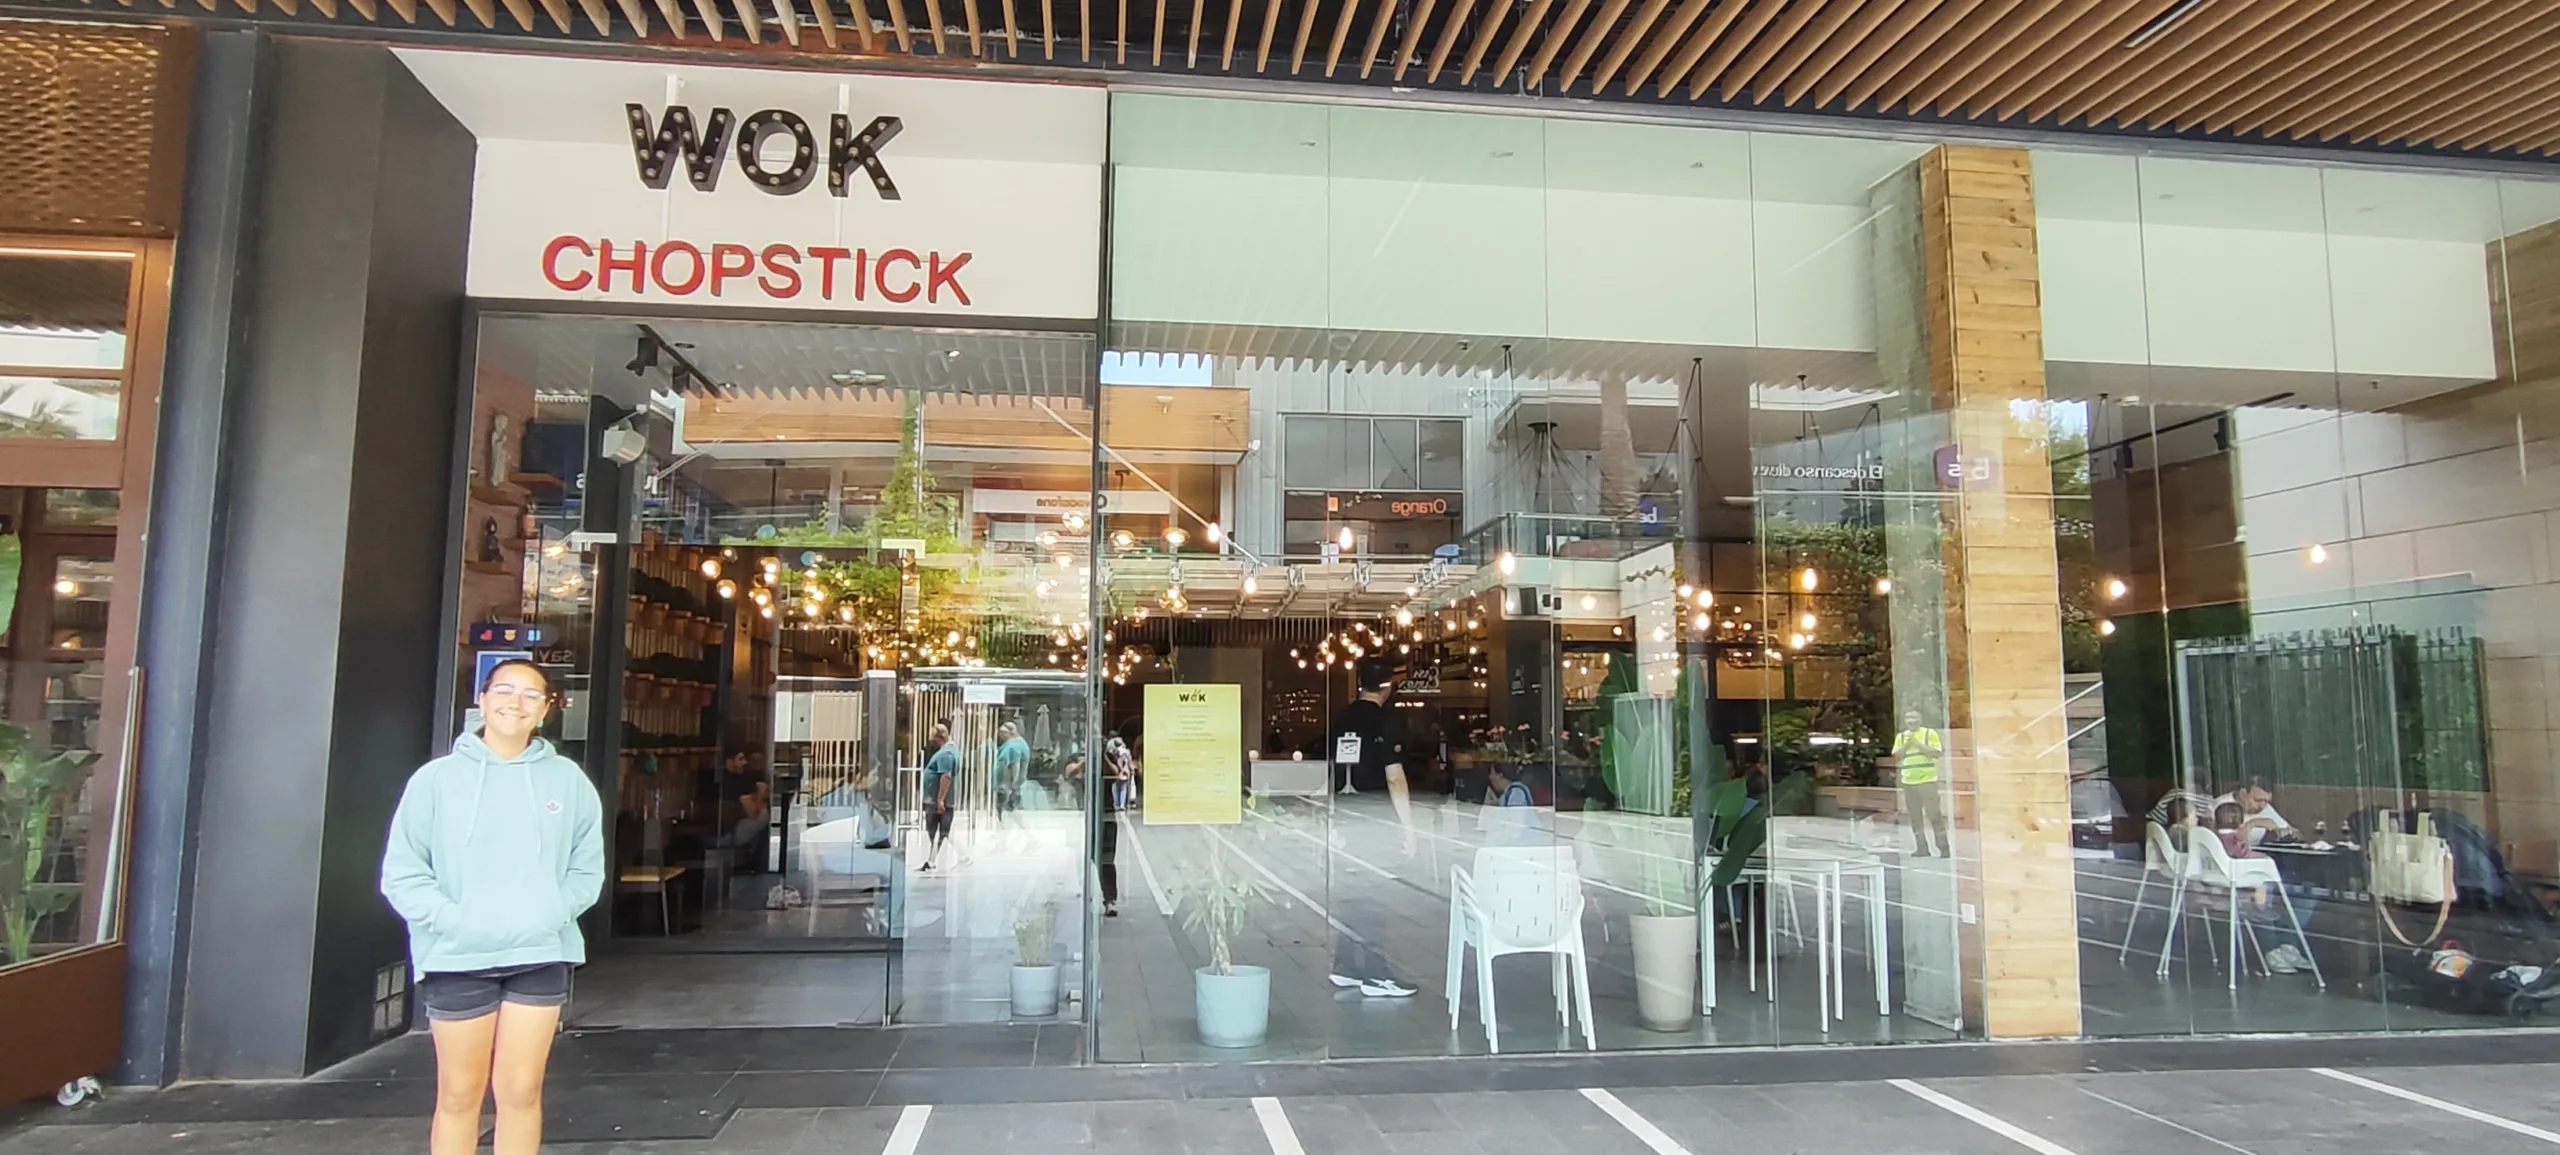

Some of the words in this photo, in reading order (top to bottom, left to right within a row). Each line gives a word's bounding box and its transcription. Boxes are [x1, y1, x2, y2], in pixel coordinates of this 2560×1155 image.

[625, 103, 903, 200] WOK
[542, 235, 973, 305] CHOPSTICK
[1179, 690, 1206, 702] WOK
